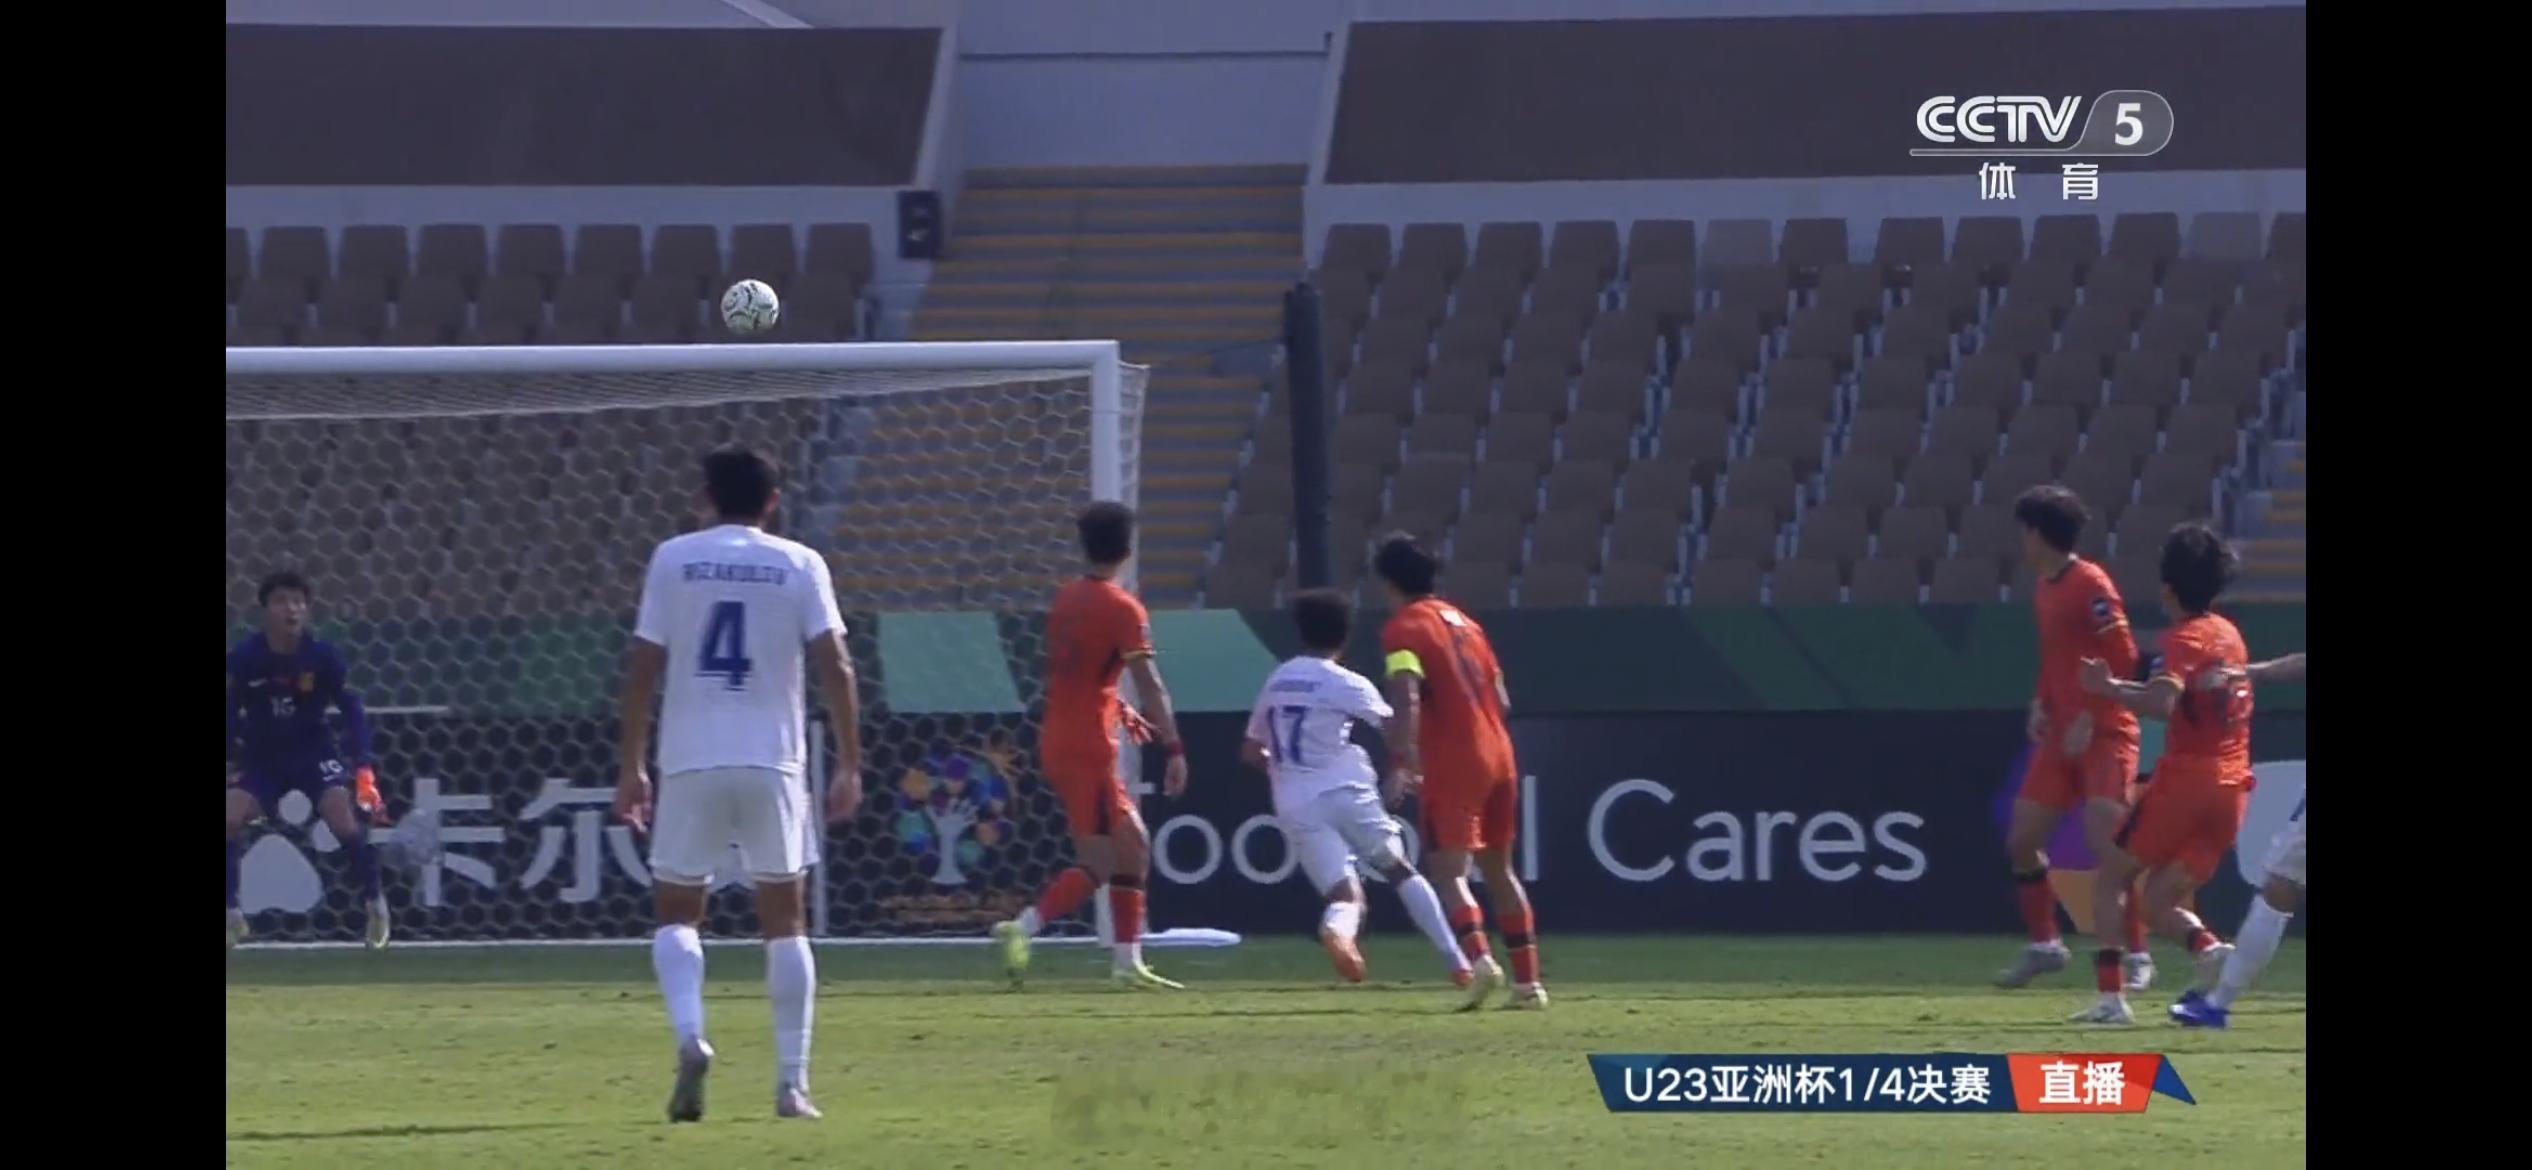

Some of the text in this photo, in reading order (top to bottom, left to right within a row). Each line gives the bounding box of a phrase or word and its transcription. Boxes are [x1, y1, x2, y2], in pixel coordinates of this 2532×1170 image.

[698, 600, 752, 688] 4
[1266, 704, 1309, 764] 17
[368, 778, 766, 906] 卡尔
[1588, 778, 1928, 883] Cares
